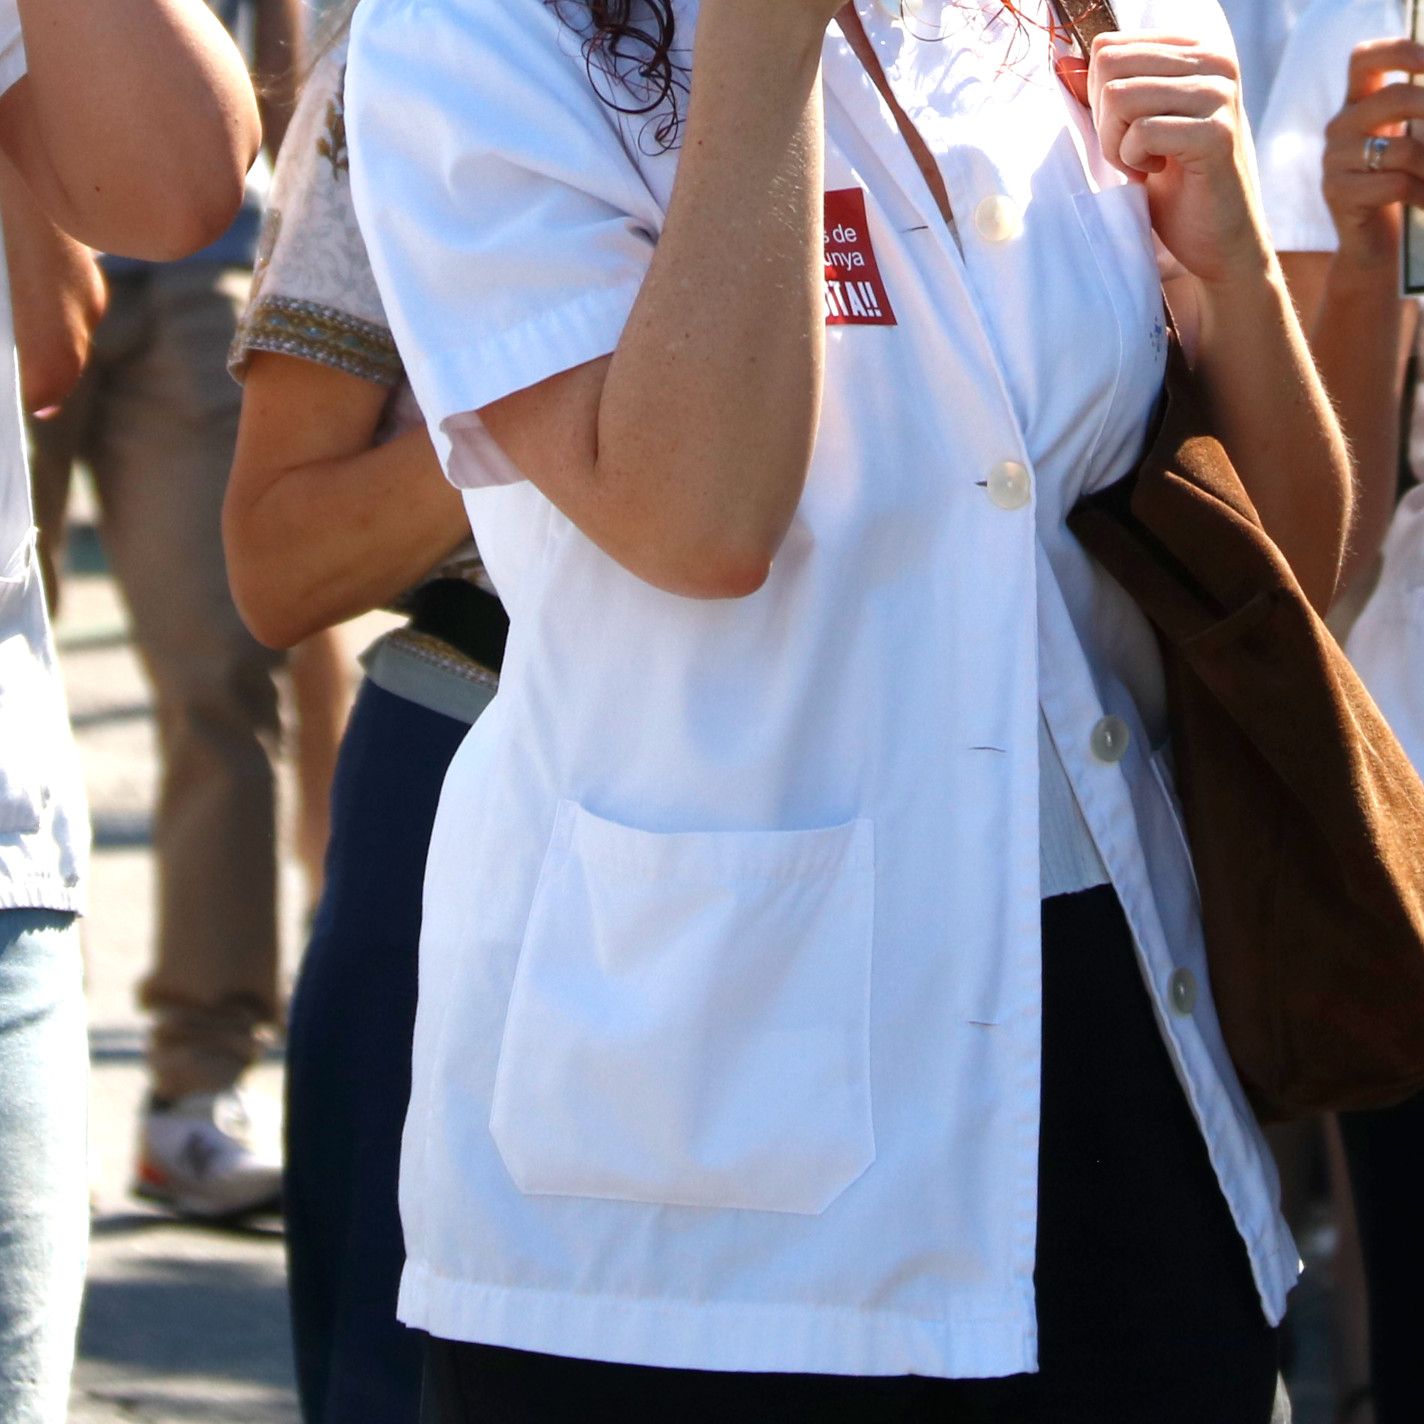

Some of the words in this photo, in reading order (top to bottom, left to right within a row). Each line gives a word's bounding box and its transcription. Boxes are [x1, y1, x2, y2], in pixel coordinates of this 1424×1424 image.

[832, 223, 857, 243] de
[824, 251, 865, 271] unya
[825, 280, 883, 317] ITA!!
